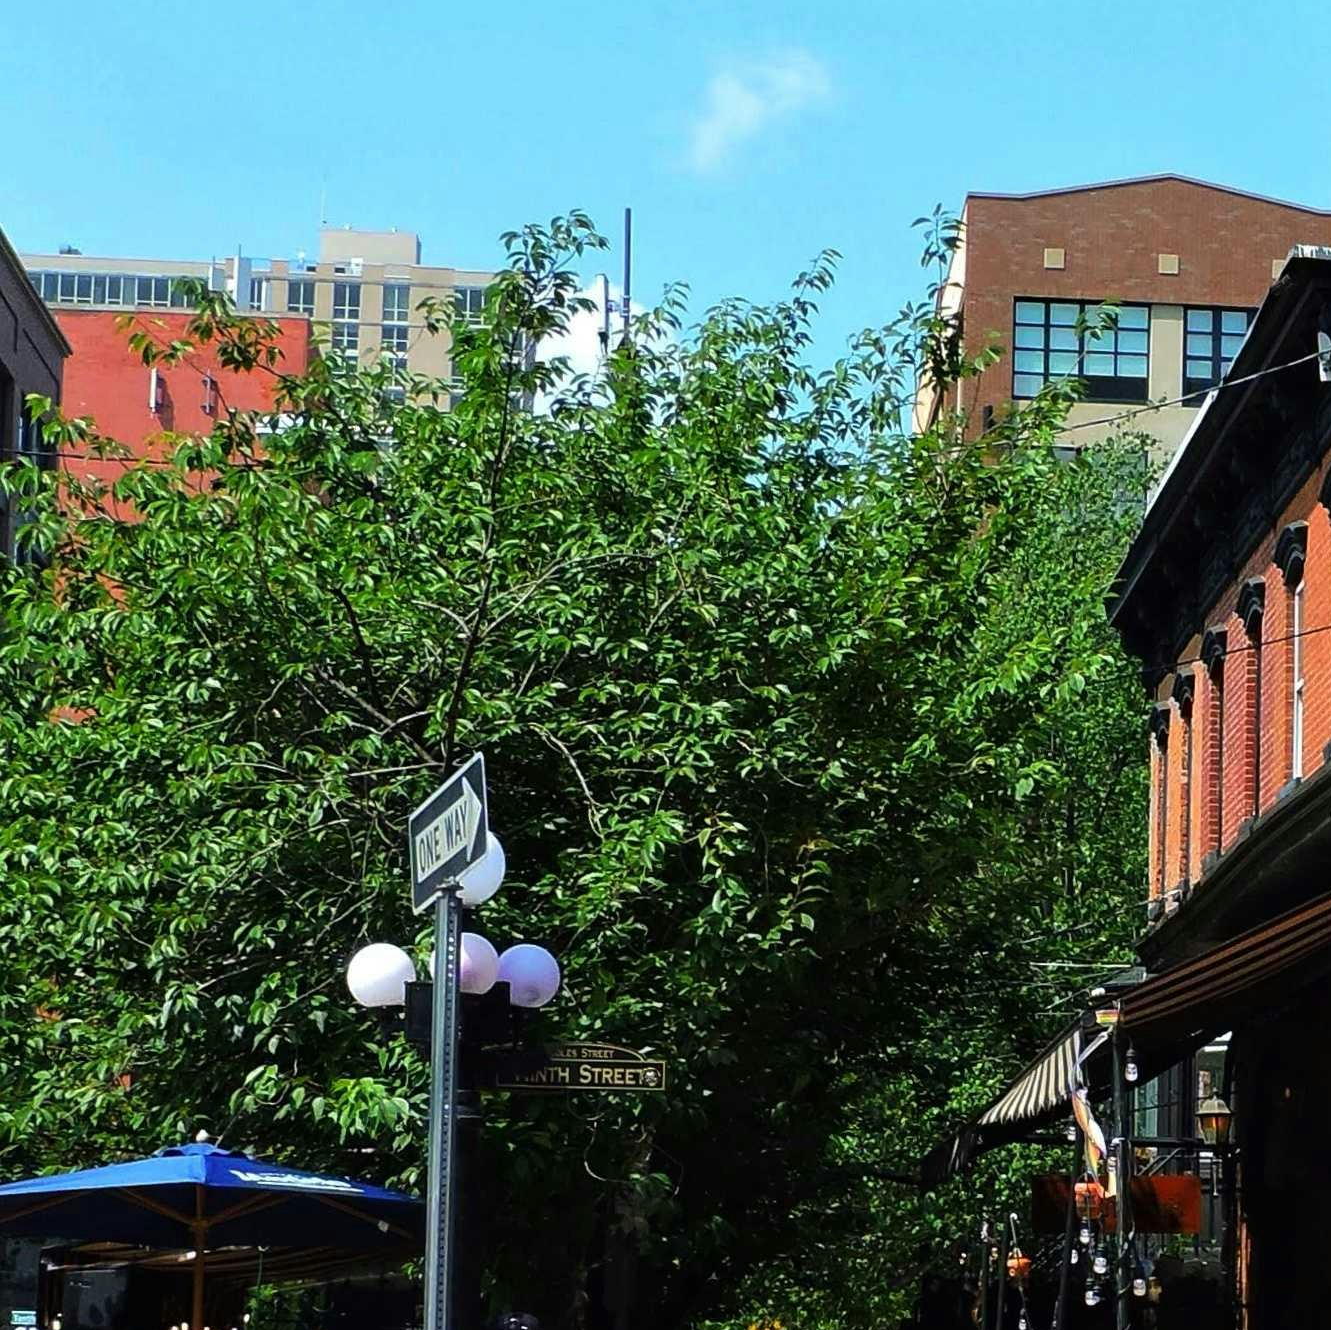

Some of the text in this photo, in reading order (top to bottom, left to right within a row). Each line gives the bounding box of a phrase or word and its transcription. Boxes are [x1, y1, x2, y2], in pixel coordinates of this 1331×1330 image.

[418, 800, 469, 873] ONE WAY
[579, 1064, 644, 1085] STREET
